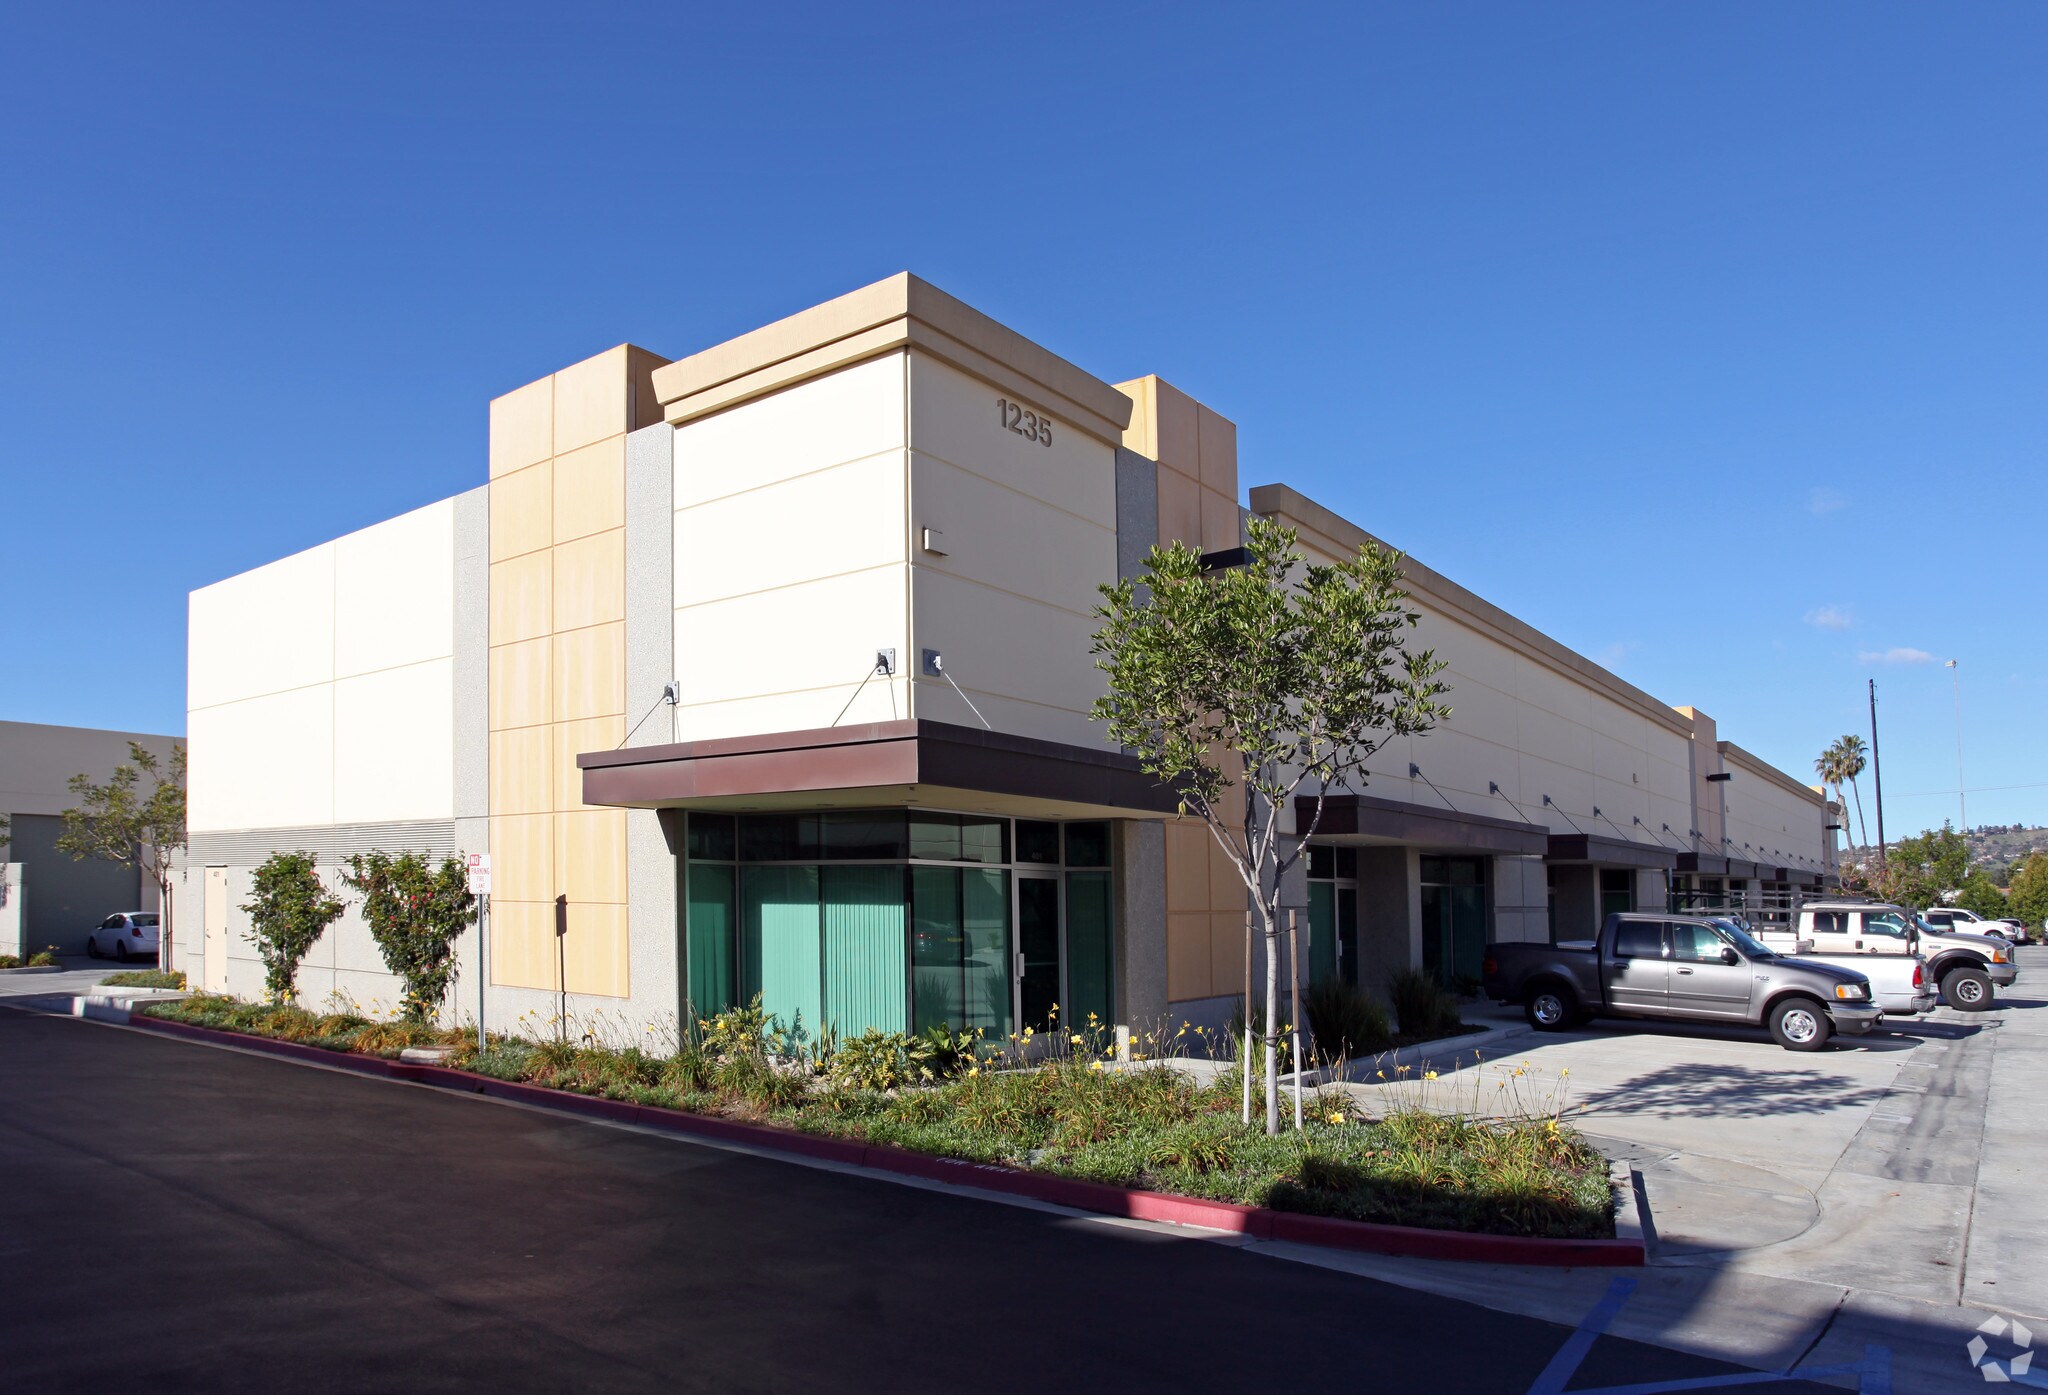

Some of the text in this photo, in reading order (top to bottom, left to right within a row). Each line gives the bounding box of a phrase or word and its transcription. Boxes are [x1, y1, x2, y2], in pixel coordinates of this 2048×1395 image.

[997, 398, 1052, 447] 1235
[471, 855, 479, 866] NO
[471, 867, 490, 875] PARKING
